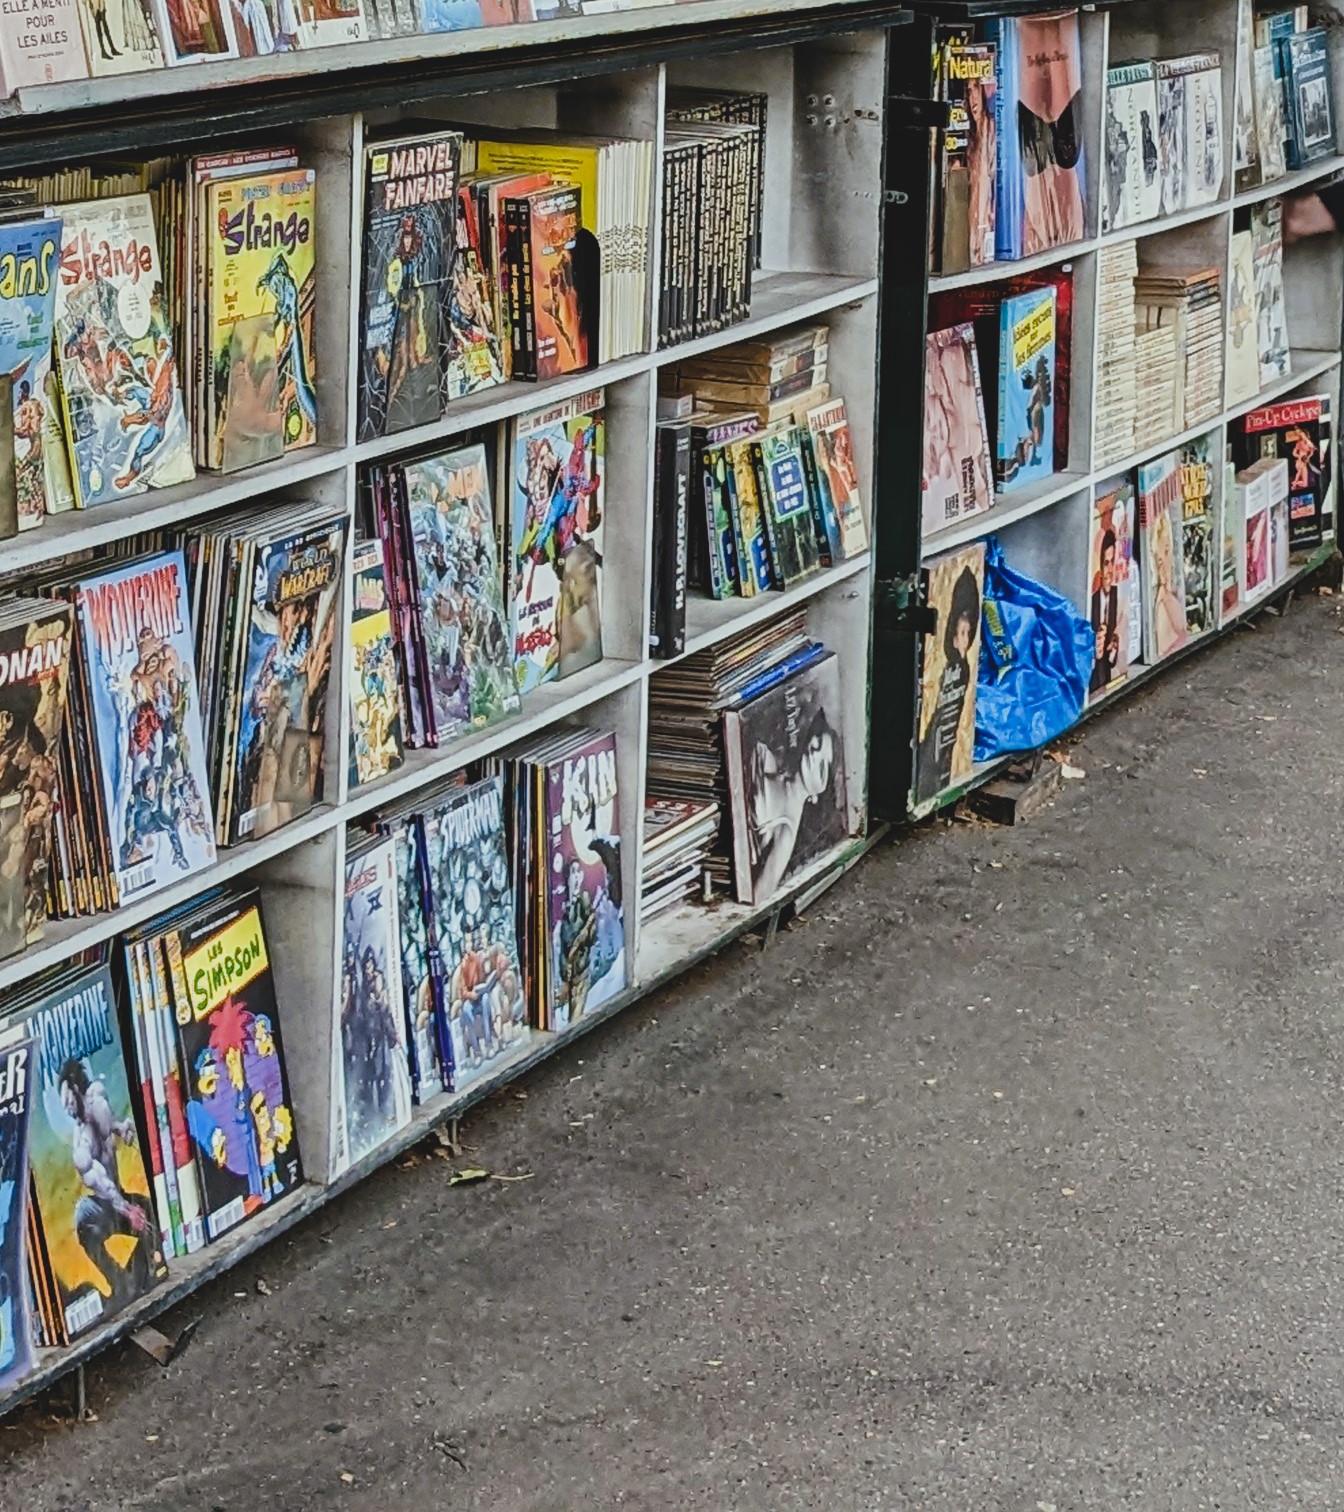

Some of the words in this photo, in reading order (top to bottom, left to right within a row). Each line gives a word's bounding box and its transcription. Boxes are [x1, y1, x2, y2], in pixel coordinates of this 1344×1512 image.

[17, 33, 38, 49] LES
[39, 31, 69, 47] AILES
[25, 14, 54, 29] POUR
[949, 56, 994, 80] Natural
[390, 141, 453, 178] MARVEL
[384, 171, 454, 211] FANFARE
[223, 200, 309, 256] Strange
[59, 228, 153, 288] Strange
[83, 564, 182, 653] WOLVERINE
[194, 934, 262, 1010] SIMPSON
[207, 941, 224, 963] LES
[27, 981, 114, 1085] WOLVERINE
